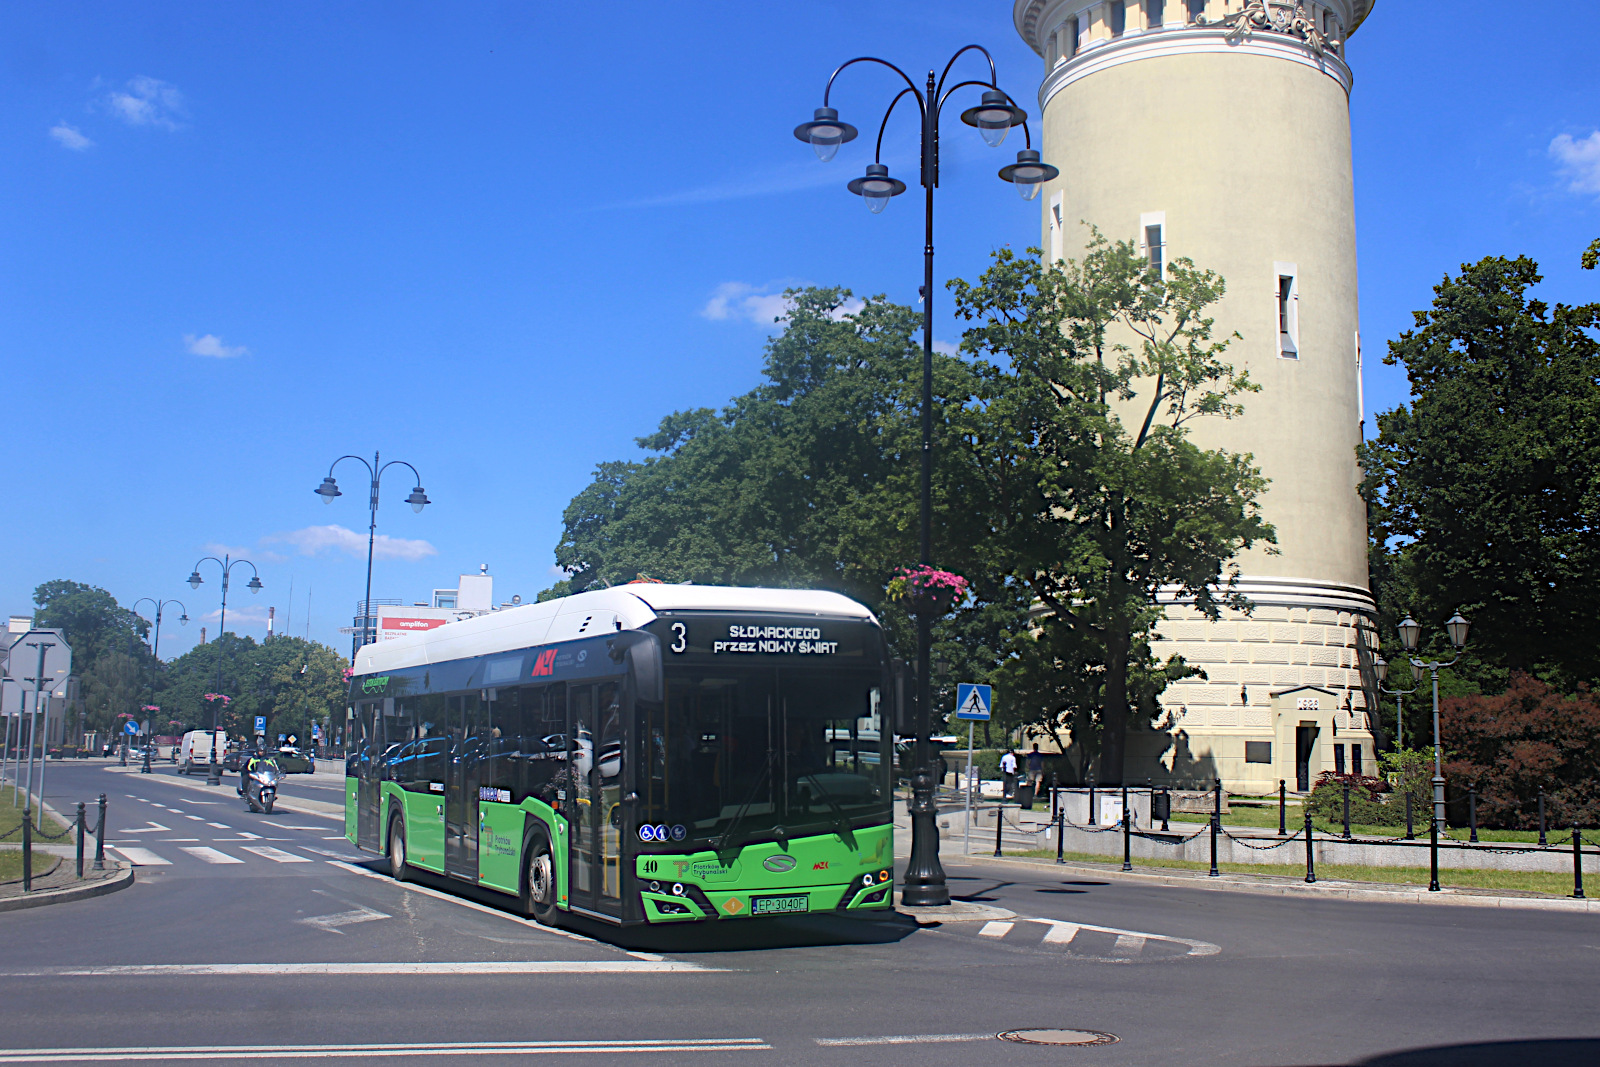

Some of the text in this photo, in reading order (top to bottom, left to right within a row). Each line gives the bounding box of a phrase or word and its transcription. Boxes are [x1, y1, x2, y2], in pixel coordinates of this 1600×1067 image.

[671, 622, 686, 653] 3
[729, 625, 821, 640] SŁOWACKIEGO
[714, 640, 838, 654] przez NOWY ŚWIAT
[256, 717, 264, 727] P
[643, 860, 658, 873] 40
[759, 899, 772, 911] EP
[775, 897, 806, 910] 3040F
